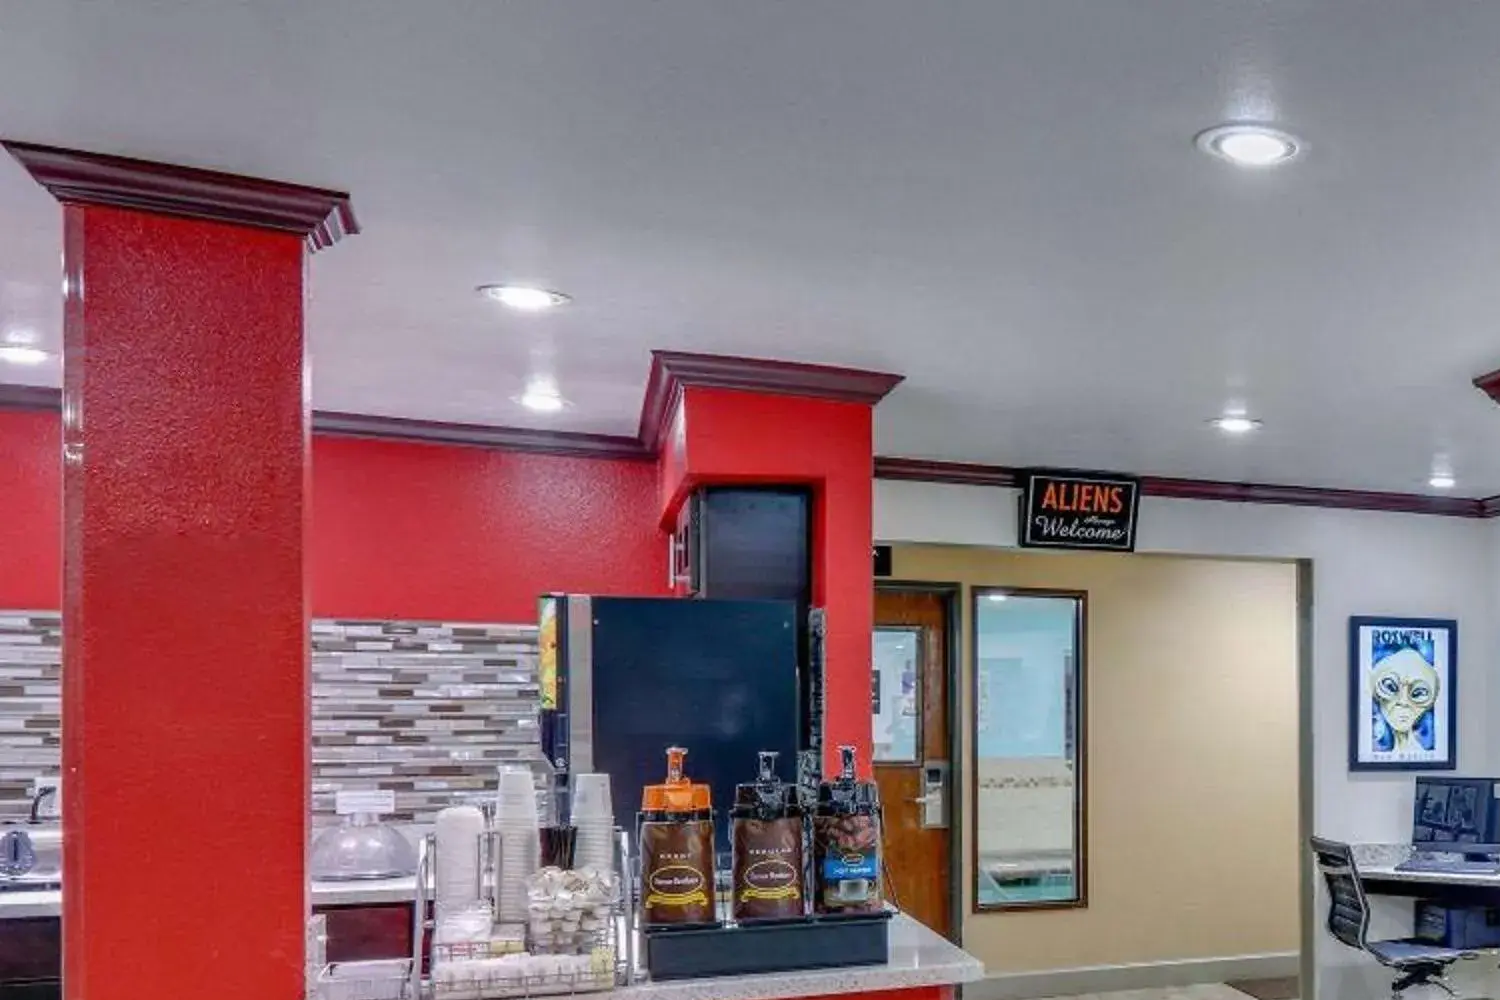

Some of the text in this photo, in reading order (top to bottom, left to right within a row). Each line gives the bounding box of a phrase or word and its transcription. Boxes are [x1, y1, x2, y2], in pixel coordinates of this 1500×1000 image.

[1042, 482, 1124, 513] ALIENS
[1036, 515, 1125, 539] Welcome
[1372, 630, 1434, 644] ROSWELL
